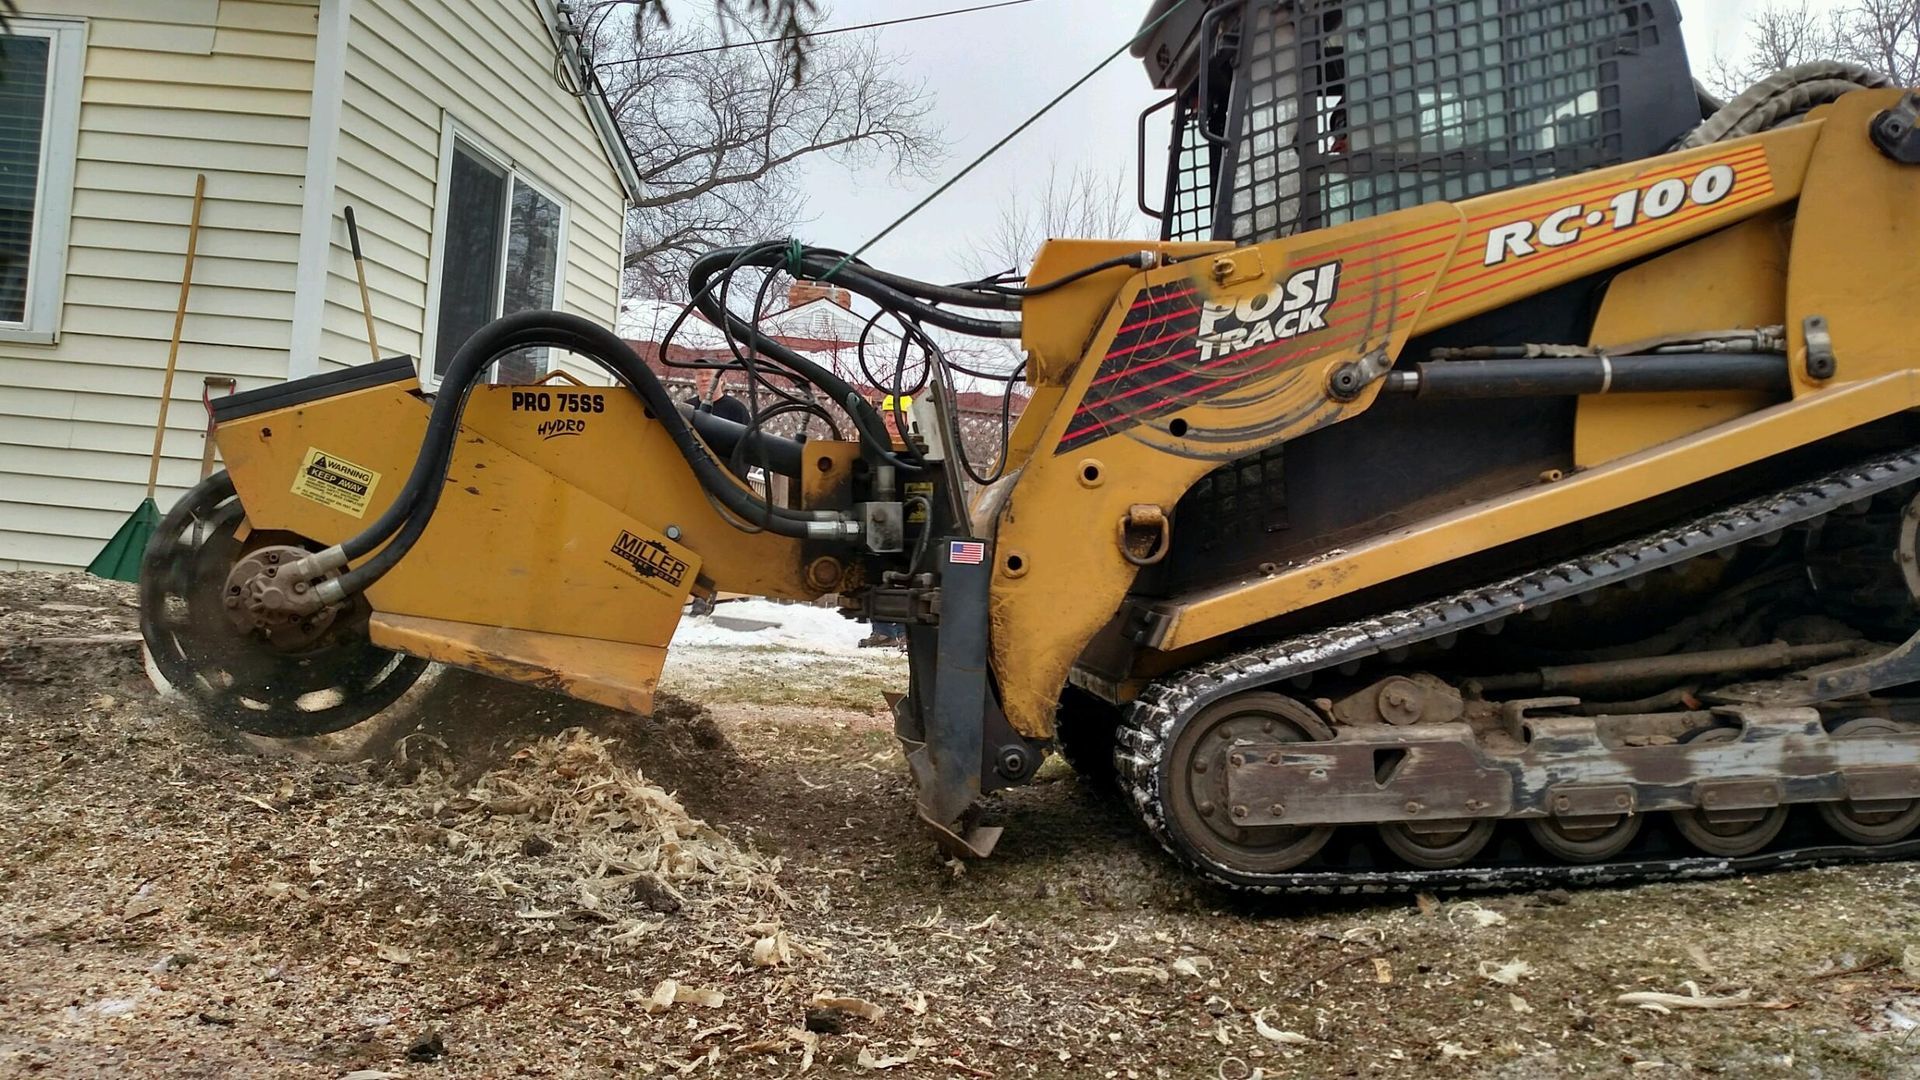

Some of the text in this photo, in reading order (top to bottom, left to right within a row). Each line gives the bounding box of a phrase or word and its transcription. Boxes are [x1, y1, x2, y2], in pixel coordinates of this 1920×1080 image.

[1198, 263, 1337, 336] POSI
[1196, 303, 1326, 361] TRACK
[512, 392, 604, 413] PRO 75SS
[538, 419, 585, 435] HYDRO
[311, 468, 363, 493] KEEP AWAY
[328, 460, 370, 482] WARNING
[618, 533, 685, 579] MILLER
